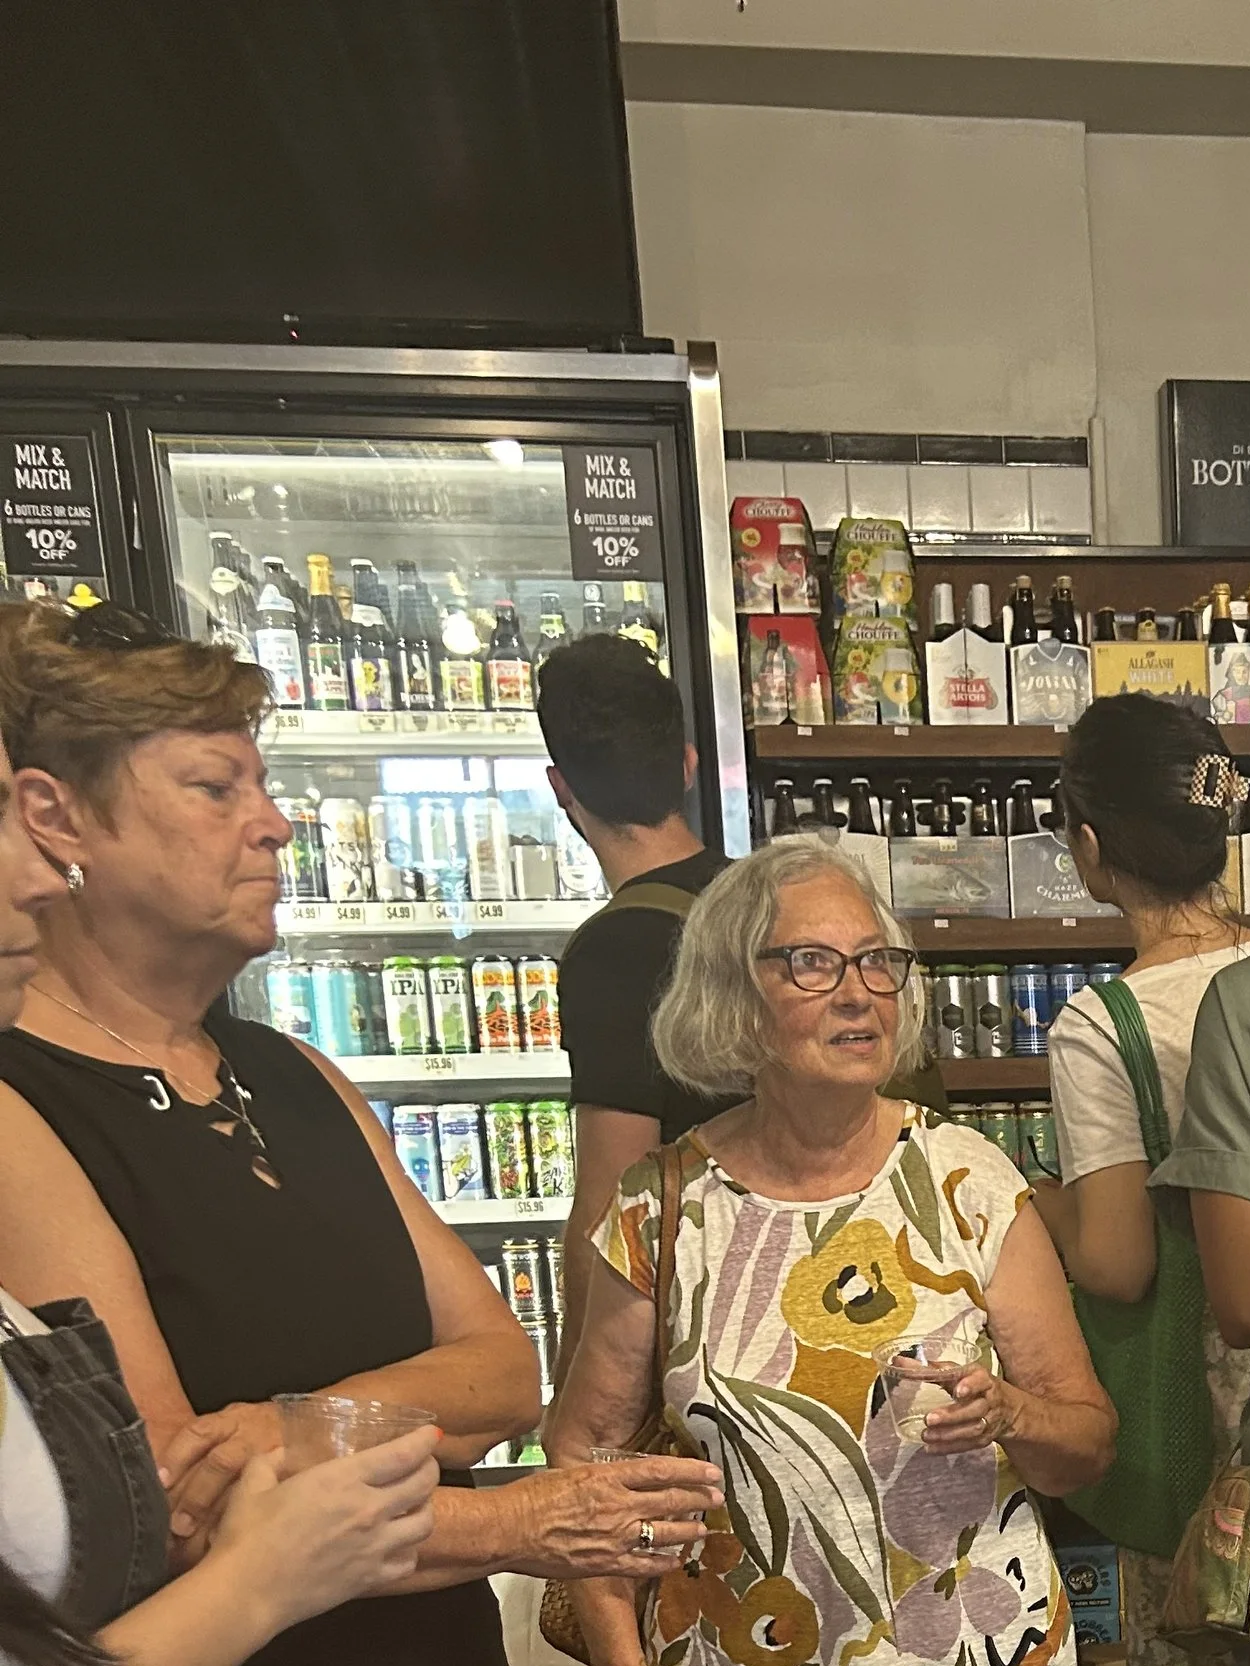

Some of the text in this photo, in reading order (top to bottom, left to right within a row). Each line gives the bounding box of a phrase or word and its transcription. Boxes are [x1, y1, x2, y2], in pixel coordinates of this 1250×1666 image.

[15, 444, 66, 467] MIX &
[1232, 445, 1244, 455] DI
[585, 454, 631, 477] MIX &
[14, 467, 72, 491] MATCH
[584, 478, 637, 499] MATCH
[4, 498, 92, 518] 6 BOTTLES OR CANS
[573, 508, 654, 527] 6 BOTTLES OR CANS
[25, 528, 77, 551] 10%
[592, 536, 640, 557] 10%
[1128, 658, 1174, 669] ALLAGASH
[950, 683, 985, 692] STELLA
[950, 692, 986, 701] ARTOIS
[1037, 885, 1090, 901] CHARME
[337, 907, 361, 920] $4.99
[386, 906, 410, 919] $4.99
[479, 905, 503, 918] $4.99
